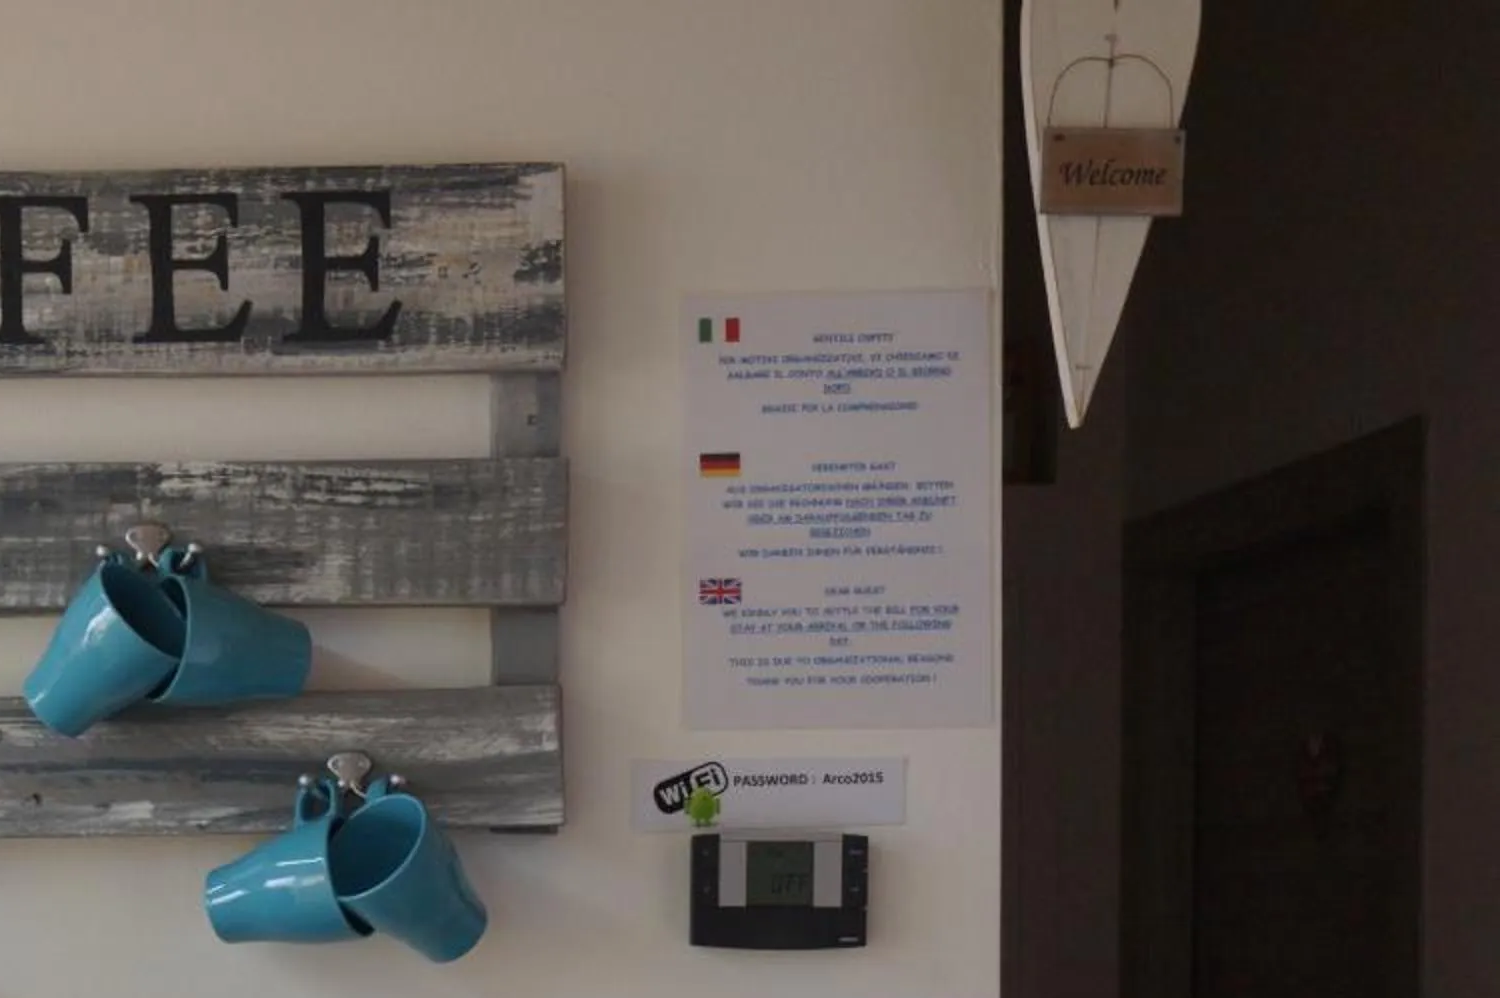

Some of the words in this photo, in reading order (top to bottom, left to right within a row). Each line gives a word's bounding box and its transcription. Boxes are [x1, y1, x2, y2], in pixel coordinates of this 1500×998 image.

[1059, 159, 1167, 187] Welcome
[733, 773, 808, 787] PASSWORD
[822, 771, 885, 786] Arco2015
